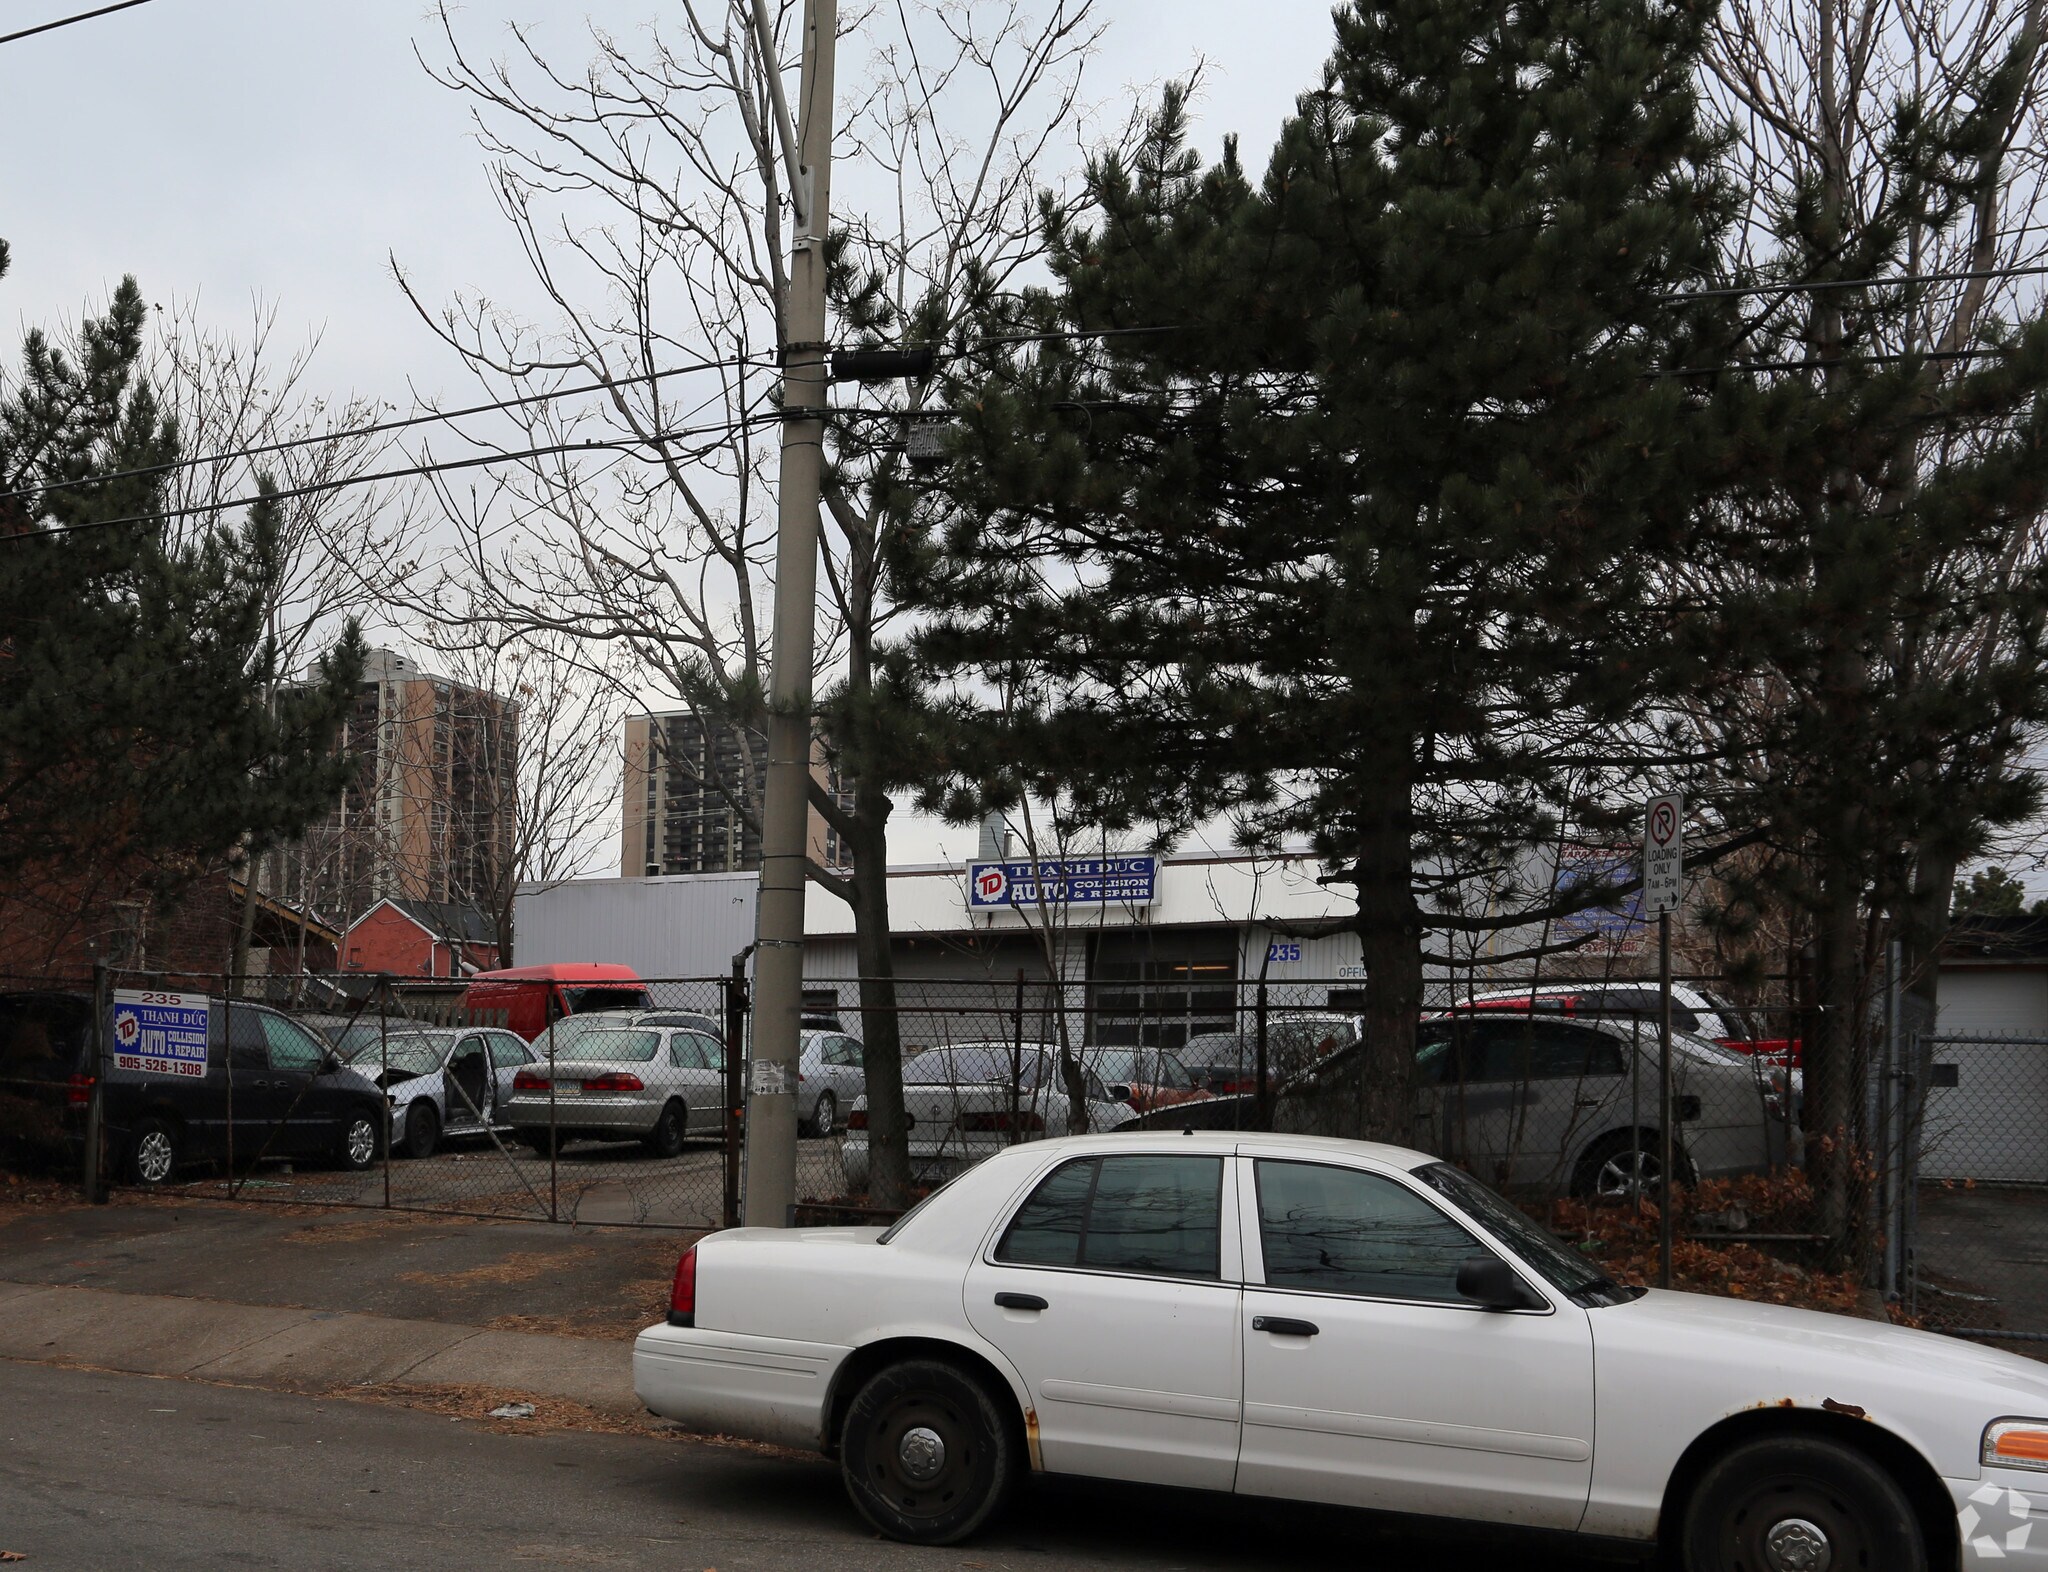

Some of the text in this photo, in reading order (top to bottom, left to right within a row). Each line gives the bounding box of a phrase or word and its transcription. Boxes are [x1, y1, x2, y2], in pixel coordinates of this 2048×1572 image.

[1648, 847, 1678, 863] LOADING
[1653, 863, 1672, 876] ONLY
[1074, 879, 1149, 889] COLLISION
[1011, 883, 1069, 901] AUTO
[1073, 888, 1149, 899] & REPAIR
[1269, 944, 1301, 962] 235
[1339, 967, 1368, 978] OFFIC
[141, 992, 181, 1005] 235
[140, 1029, 165, 1055] AUTO
[167, 1030, 205, 1045] COLLISION
[167, 1044, 205, 1059] & REPAIR
[119, 1056, 202, 1076] 905-526-1308
